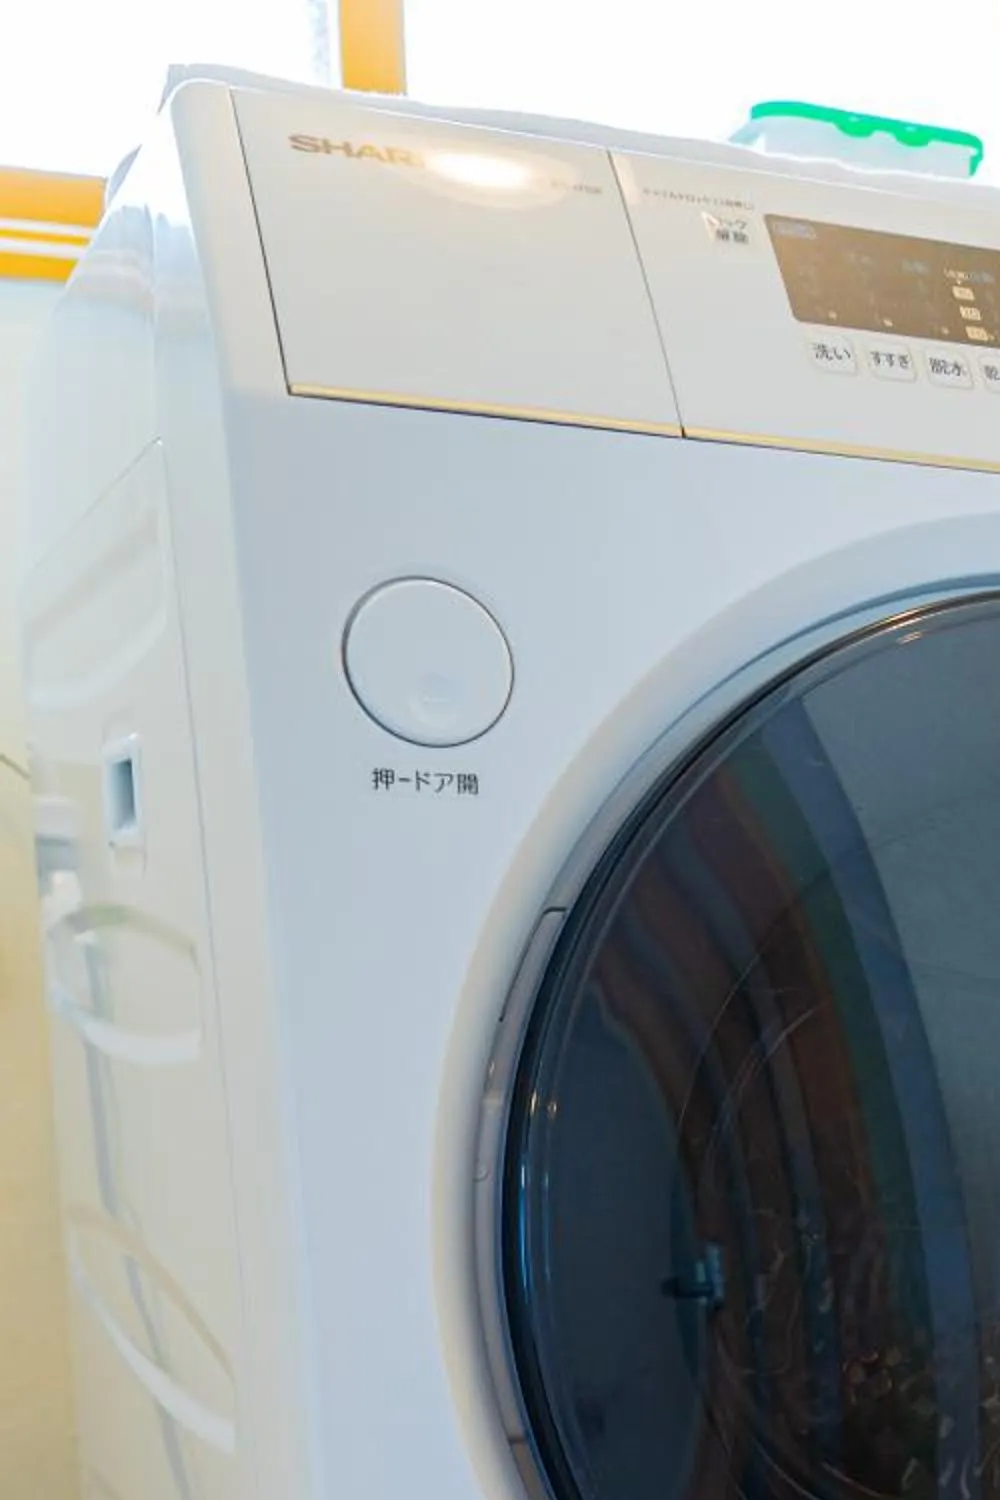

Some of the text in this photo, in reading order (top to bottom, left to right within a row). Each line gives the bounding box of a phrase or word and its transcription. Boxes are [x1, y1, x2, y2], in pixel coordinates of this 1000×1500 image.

[288, 133, 427, 169] SHAR
[813, 342, 850, 361] 洗い
[871, 350, 909, 369] すすぎ
